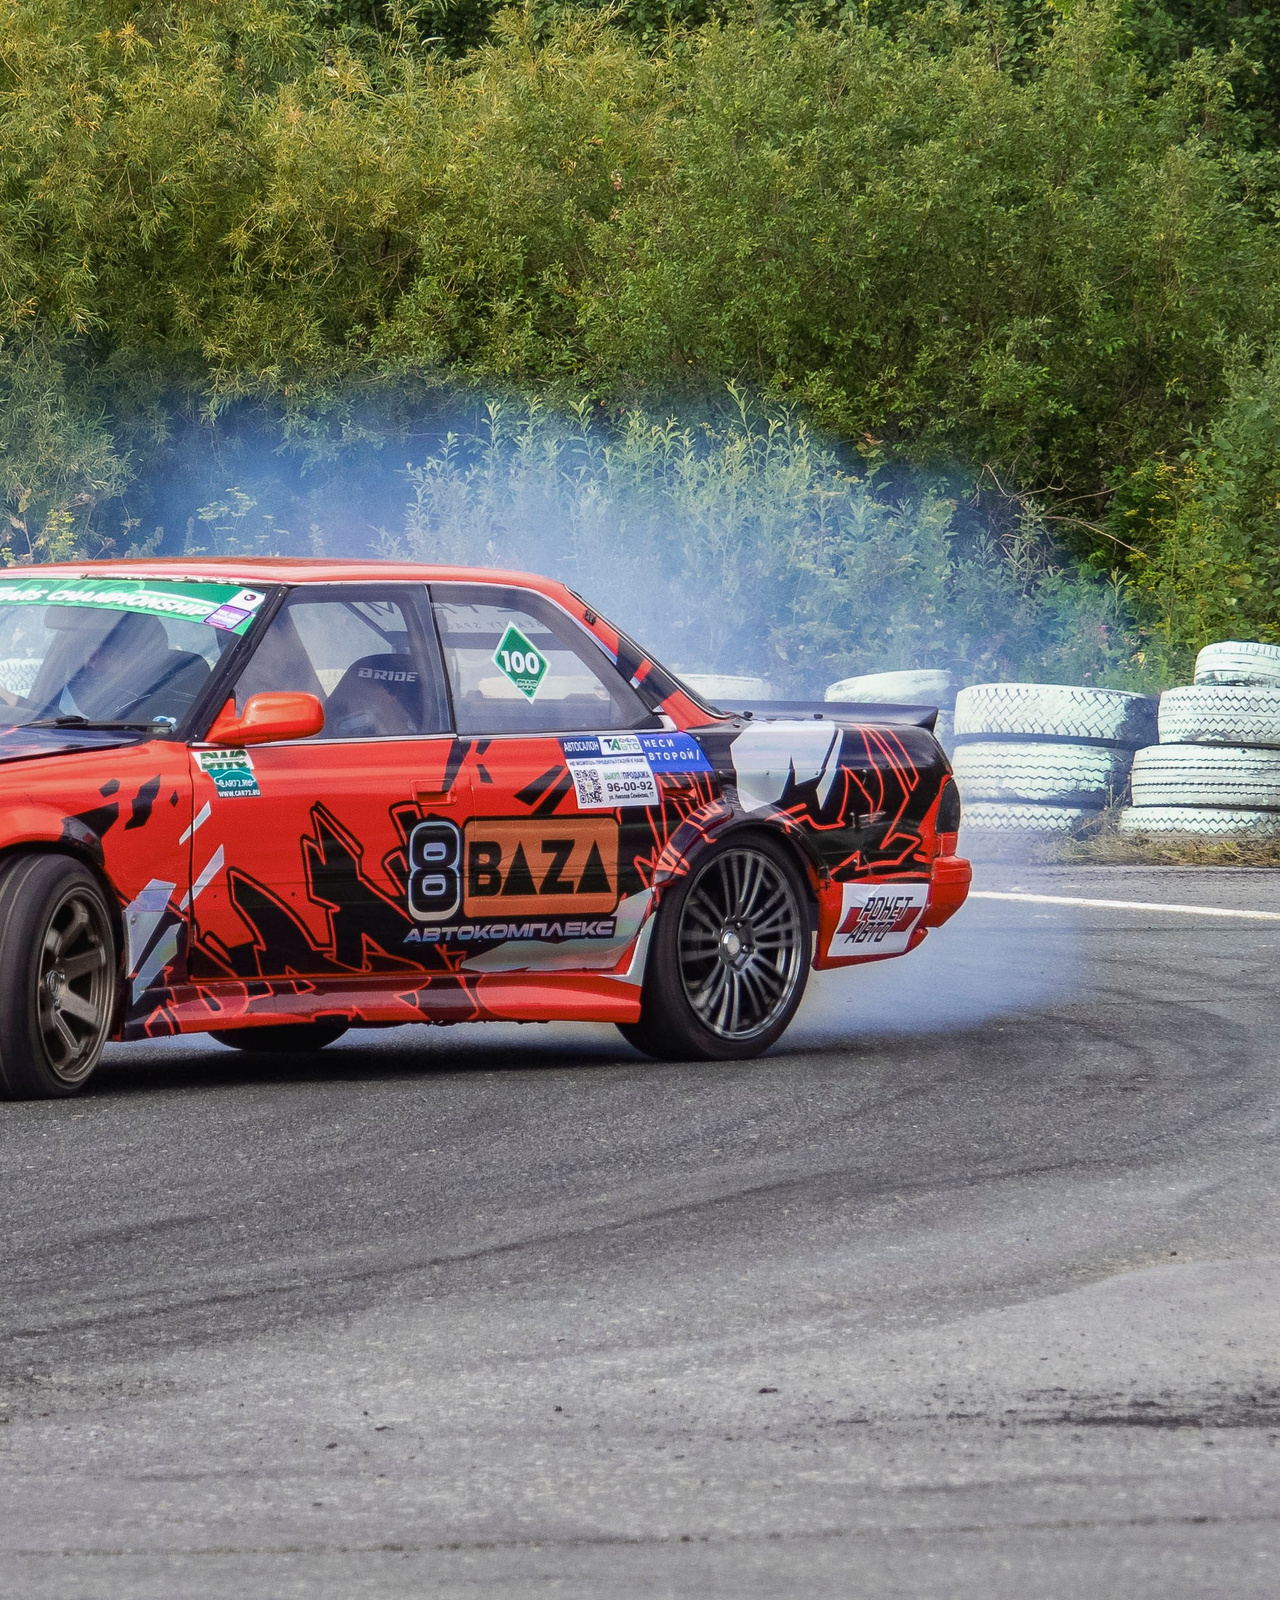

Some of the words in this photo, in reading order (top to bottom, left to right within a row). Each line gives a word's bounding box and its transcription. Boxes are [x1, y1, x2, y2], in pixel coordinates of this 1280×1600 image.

[49, 590, 213, 616] CHAMPIONSHIP
[501, 651, 539, 674] 100
[358, 667, 418, 682] BRIDE
[564, 741, 600, 751] АВТОСАЛОН
[607, 781, 653, 792] 96-00-92
[468, 839, 613, 897] BAZA
[403, 920, 615, 944] АВТОКОМПЛЕКС
